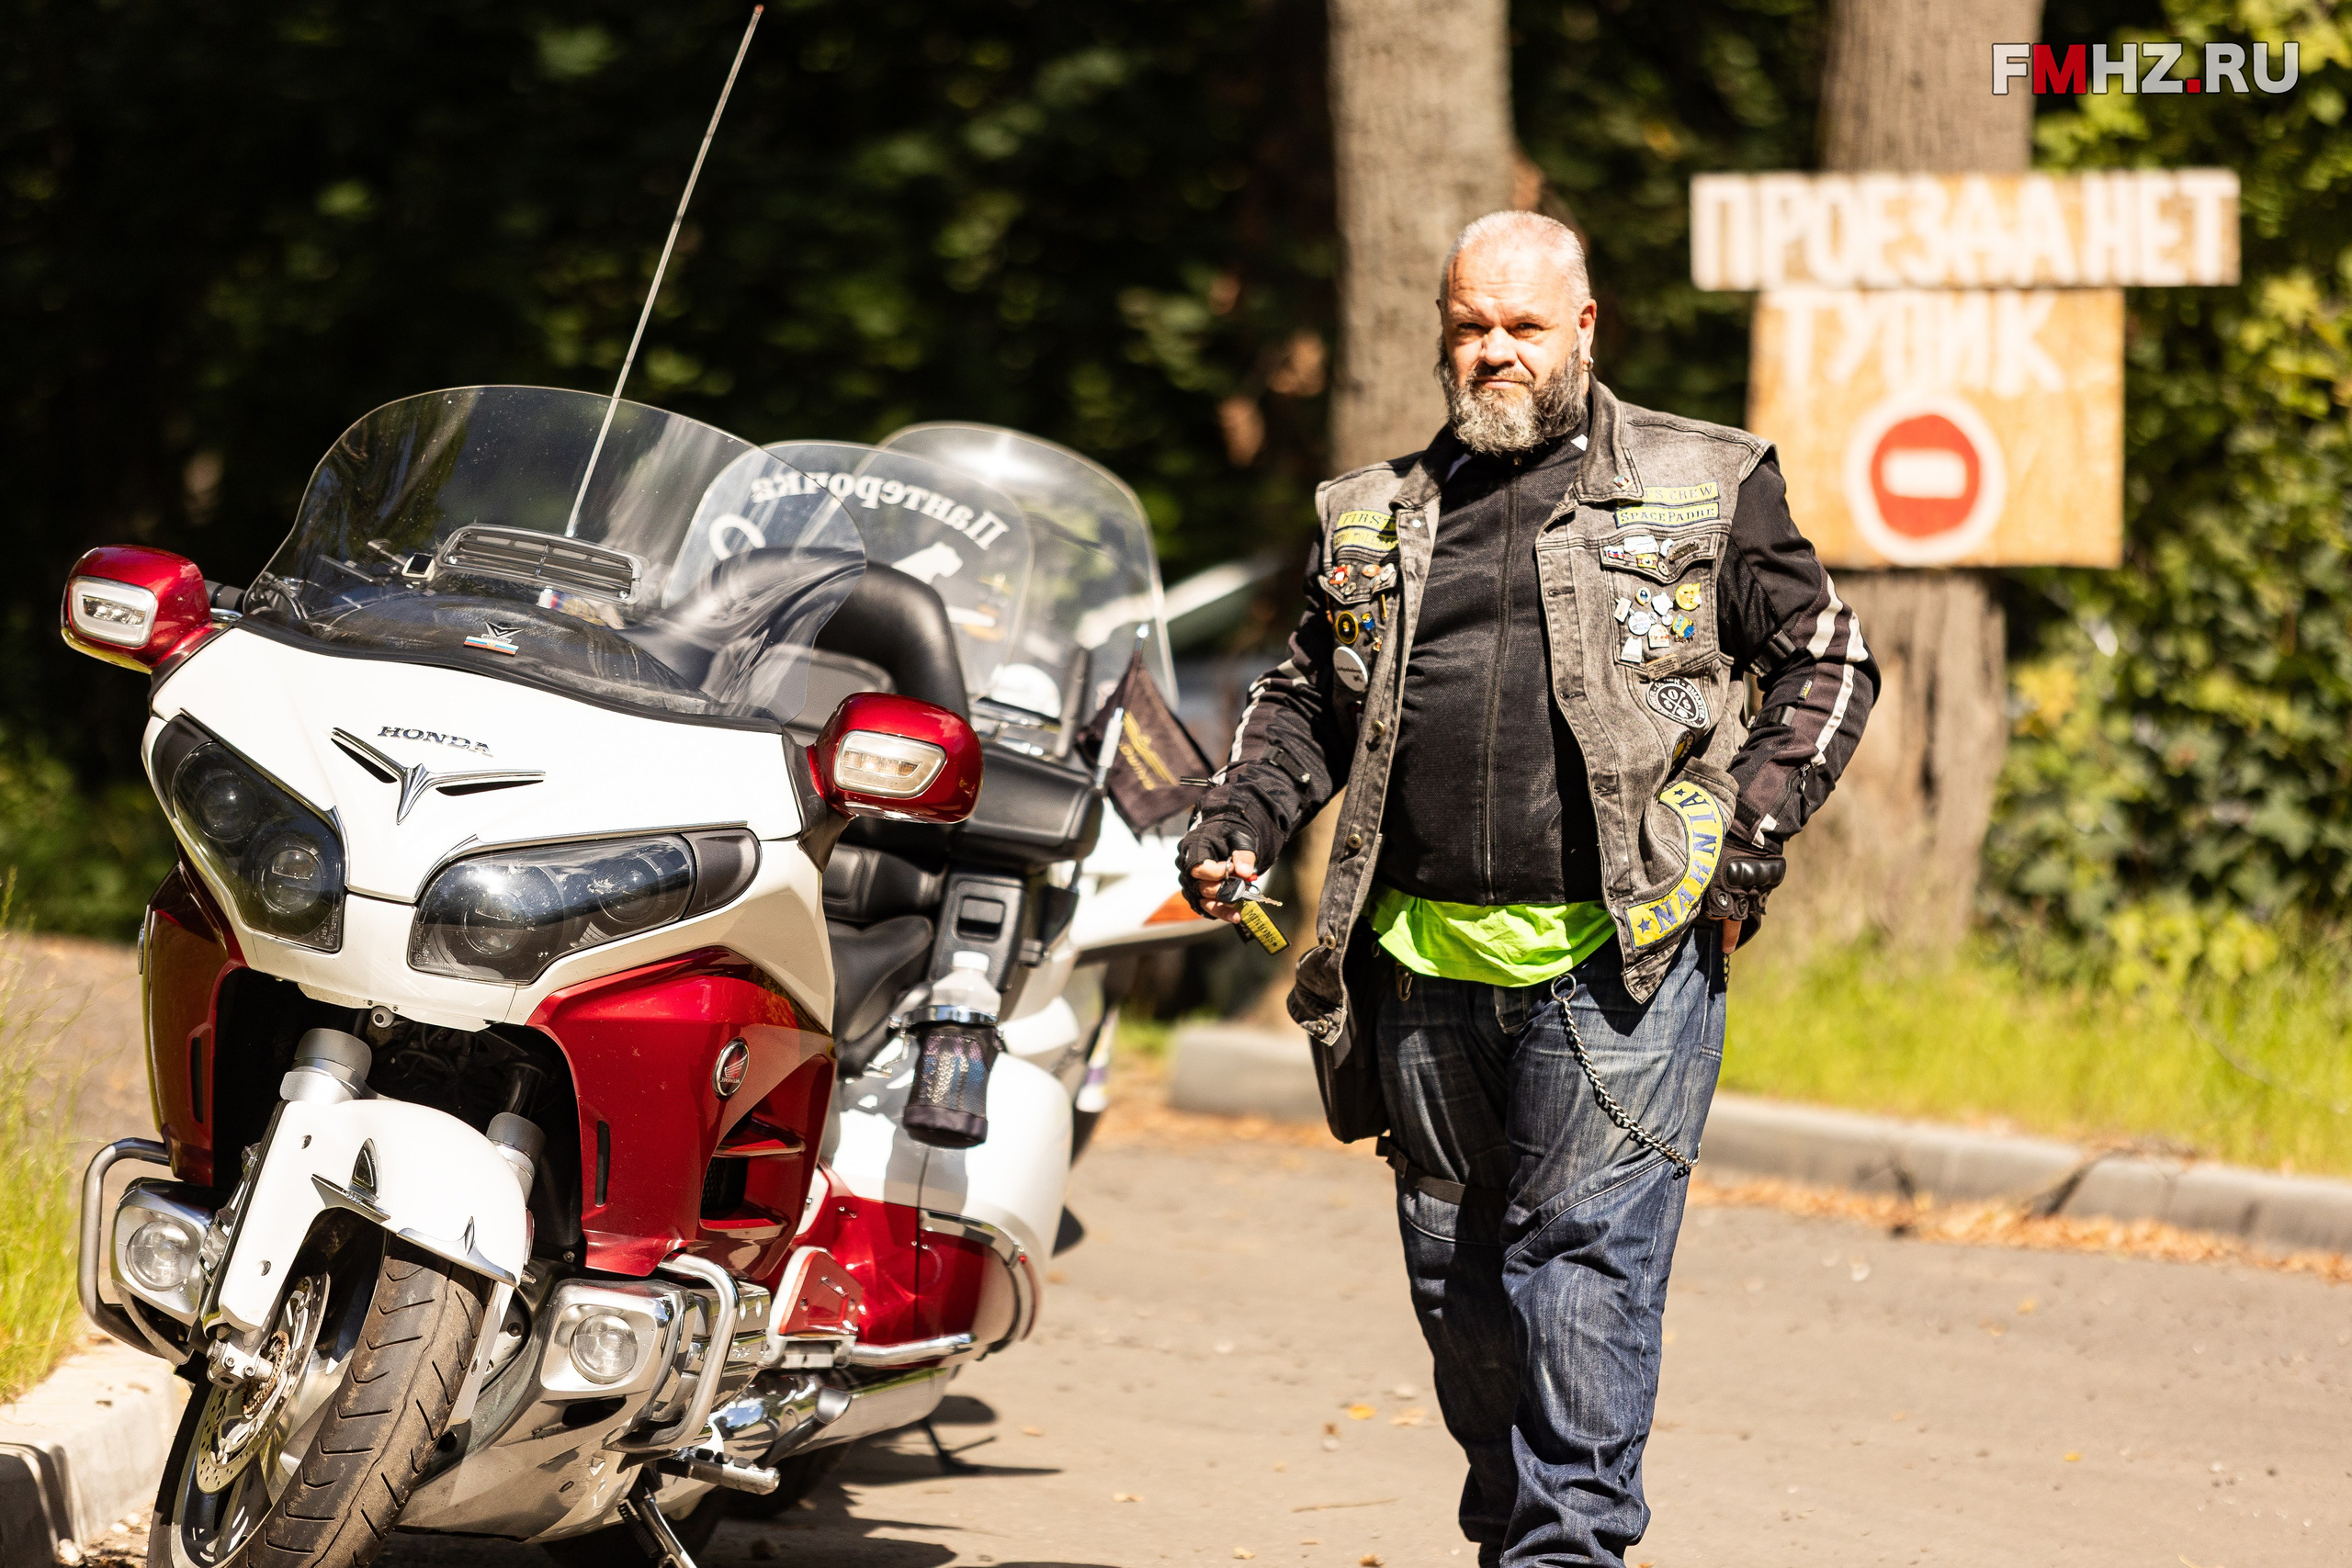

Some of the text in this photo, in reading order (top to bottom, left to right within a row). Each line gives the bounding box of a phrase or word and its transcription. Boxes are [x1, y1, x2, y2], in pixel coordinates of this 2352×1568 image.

[1692, 169, 2240, 287] ПРОЕЗДА НЕТ
[1760, 287, 2067, 398] ТУПИК
[377, 726, 494, 758] HONDA
[1649, 791, 1718, 934] NARNIA
[1247, 908, 1276, 943] MINIONS
